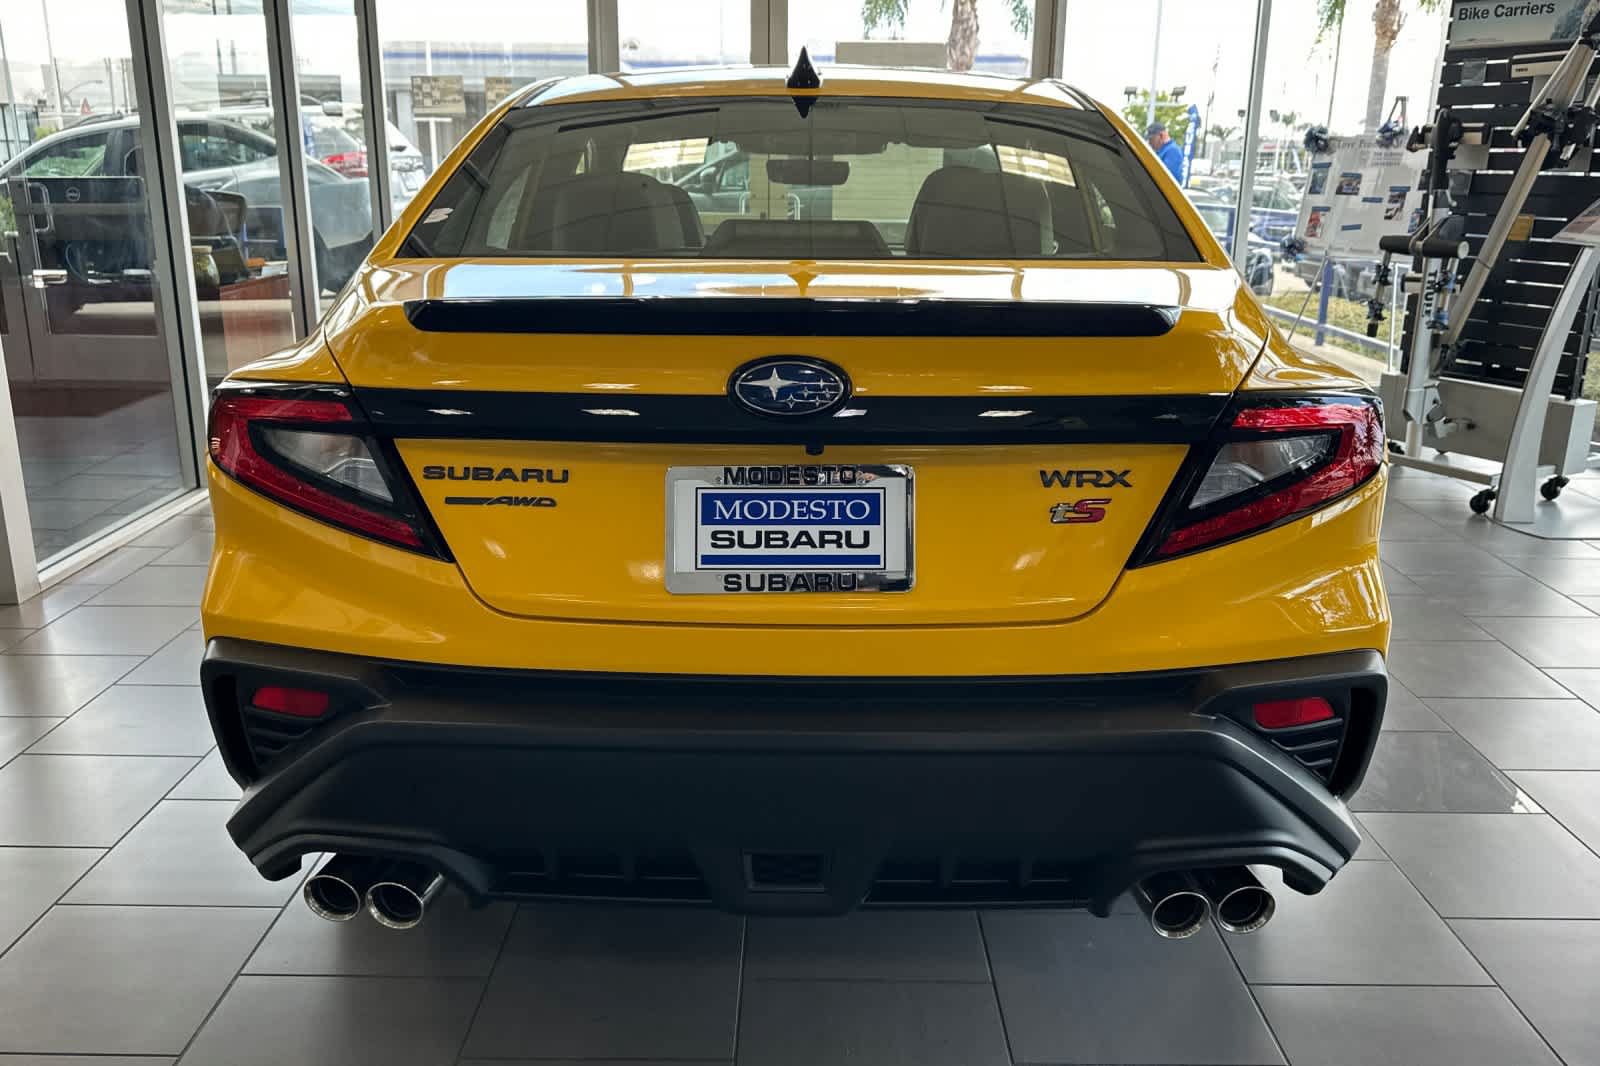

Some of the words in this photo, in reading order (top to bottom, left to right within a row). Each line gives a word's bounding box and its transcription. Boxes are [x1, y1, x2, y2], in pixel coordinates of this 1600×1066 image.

[1458, 7, 1489, 21] Bike
[1494, 2, 1555, 17] Carriers
[423, 466, 569, 483] SUBARU
[723, 466, 858, 485] MODESTO
[1040, 470, 1132, 488] WRX
[483, 496, 557, 507] AWD
[713, 500, 870, 520] MODESTO
[710, 530, 870, 549] SUBARU
[723, 573, 858, 592] SUBARU
